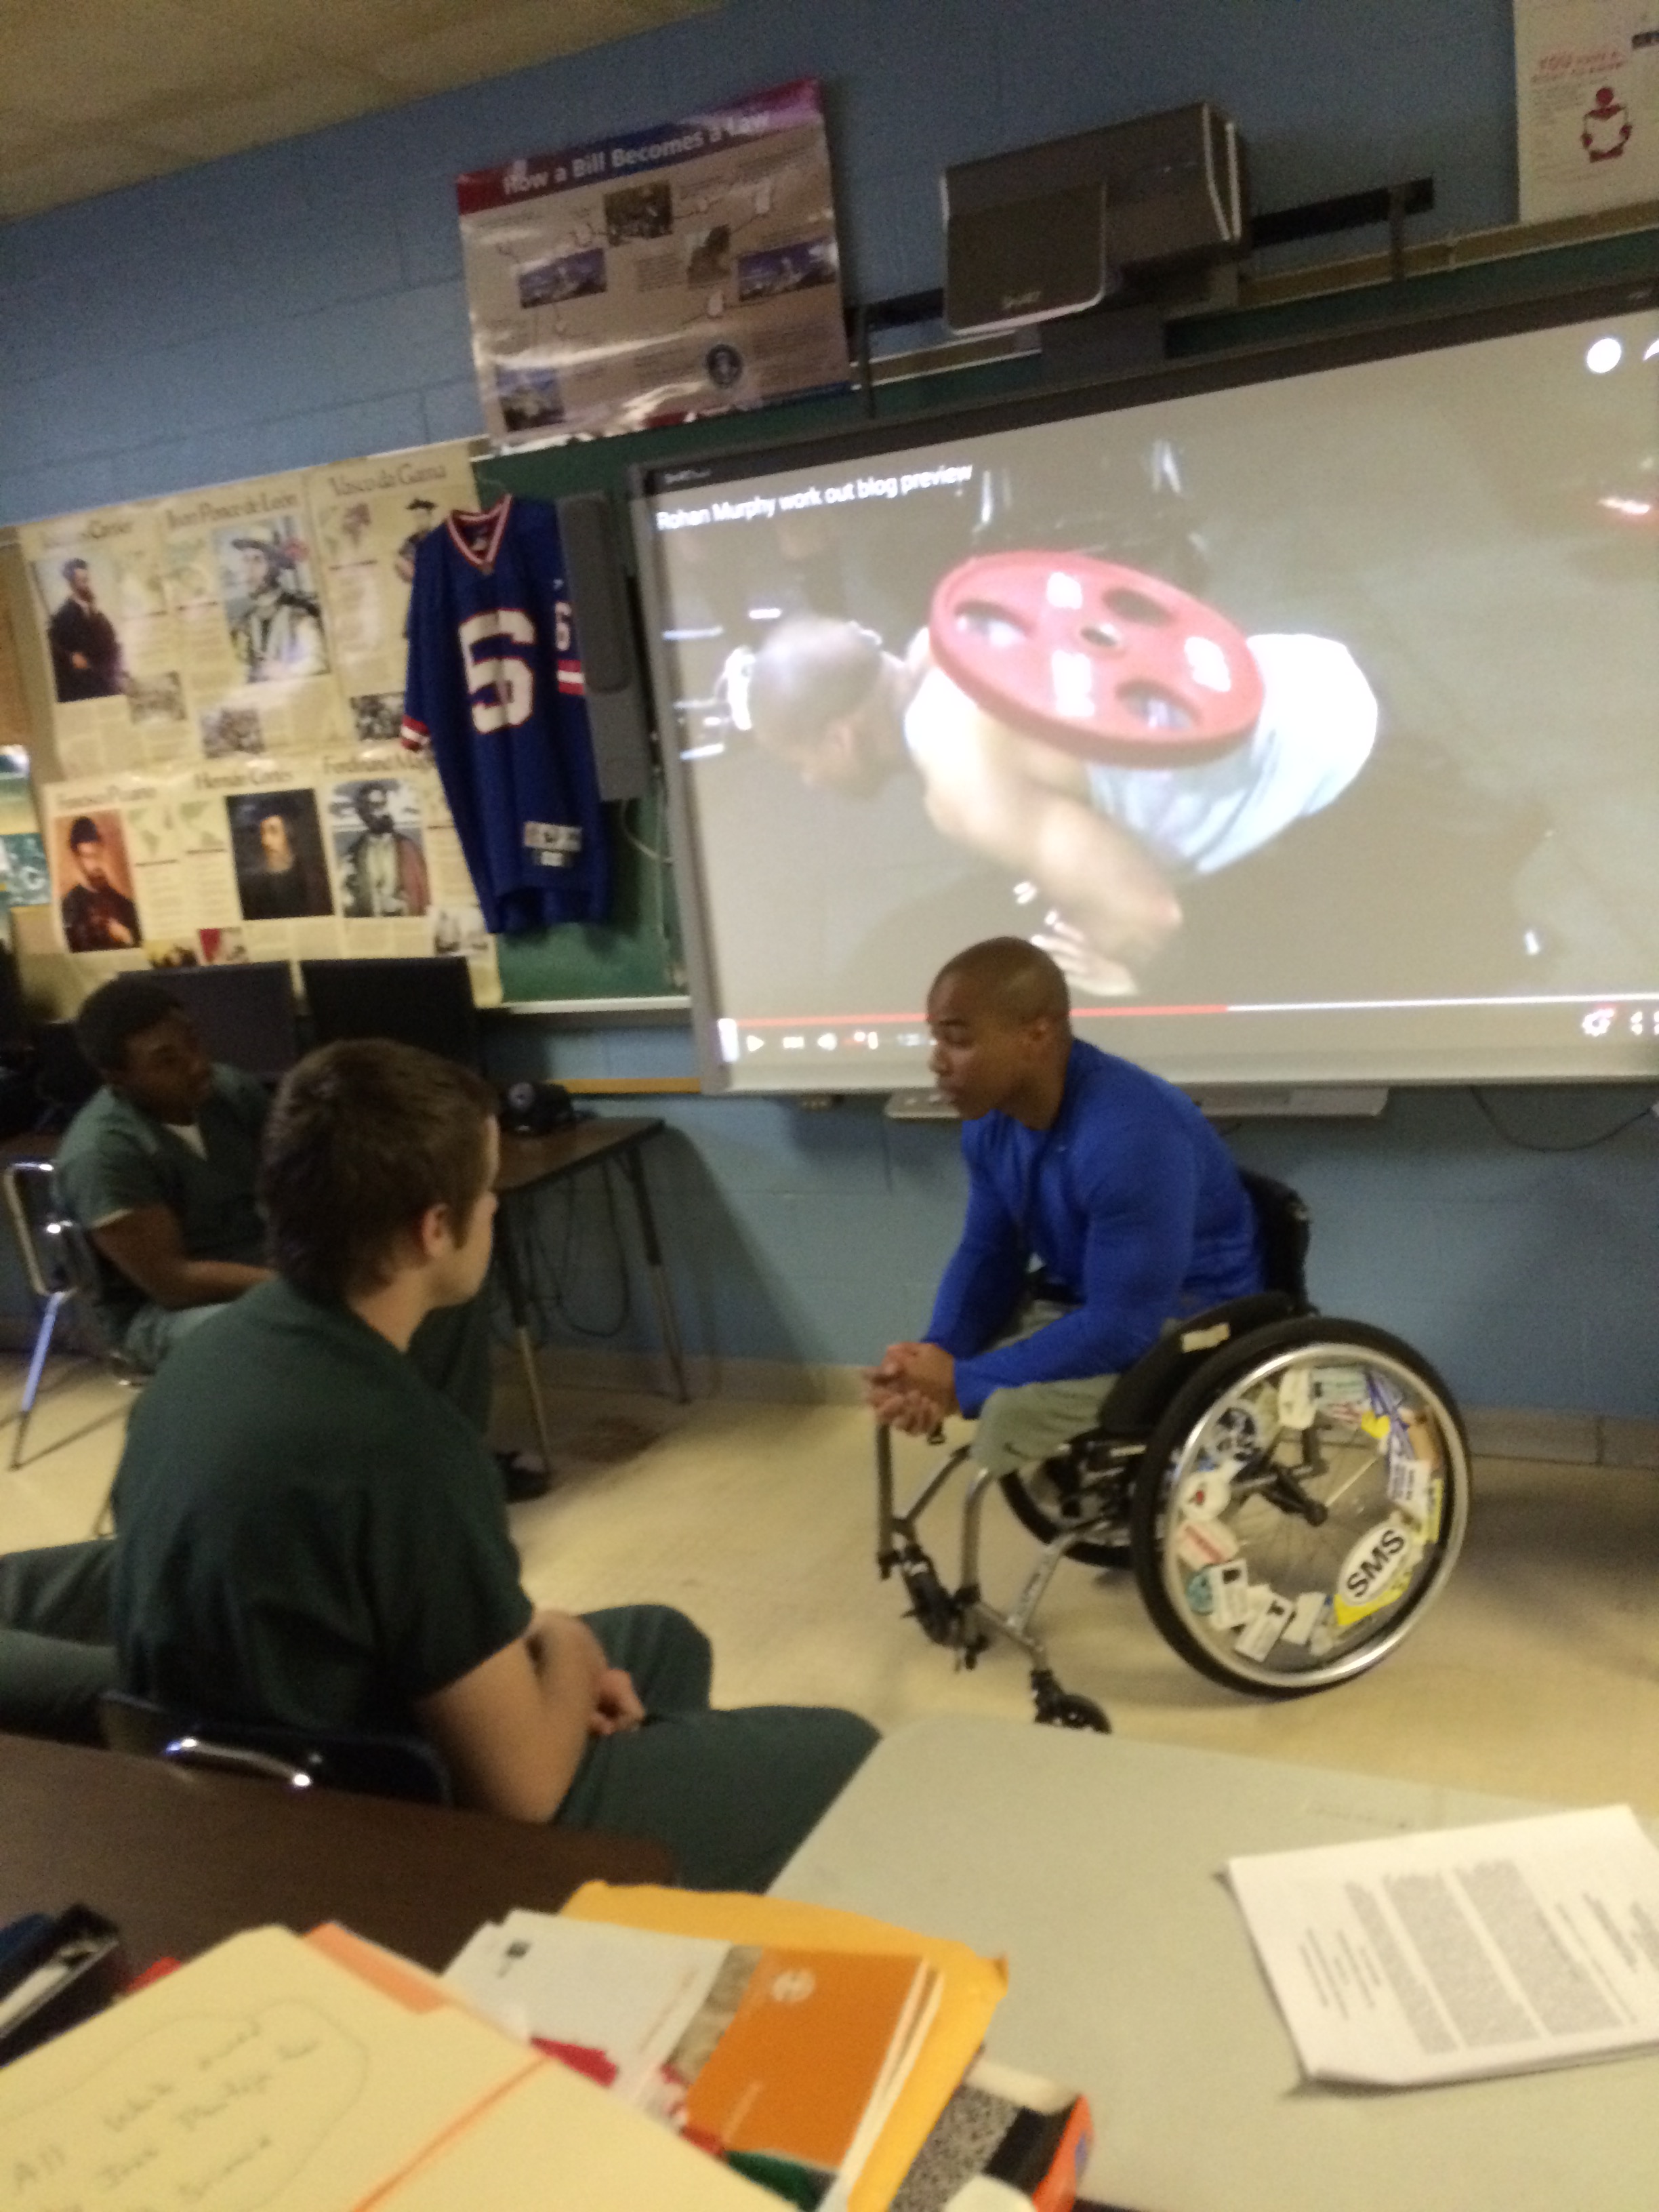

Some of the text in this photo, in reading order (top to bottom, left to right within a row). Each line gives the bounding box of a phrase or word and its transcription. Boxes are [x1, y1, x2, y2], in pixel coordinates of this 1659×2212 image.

[502, 169, 549, 195] How
[554, 167, 568, 184] a
[571, 151, 606, 178] Bill
[611, 131, 705, 168] Becomes
[726, 111, 771, 136] Law
[712, 496, 776, 521] Murphy
[779, 485, 822, 510] work
[824, 483, 855, 504] out
[857, 476, 898, 499] blog
[901, 464, 973, 495] preview
[1347, 1529, 1404, 1598] SMS
